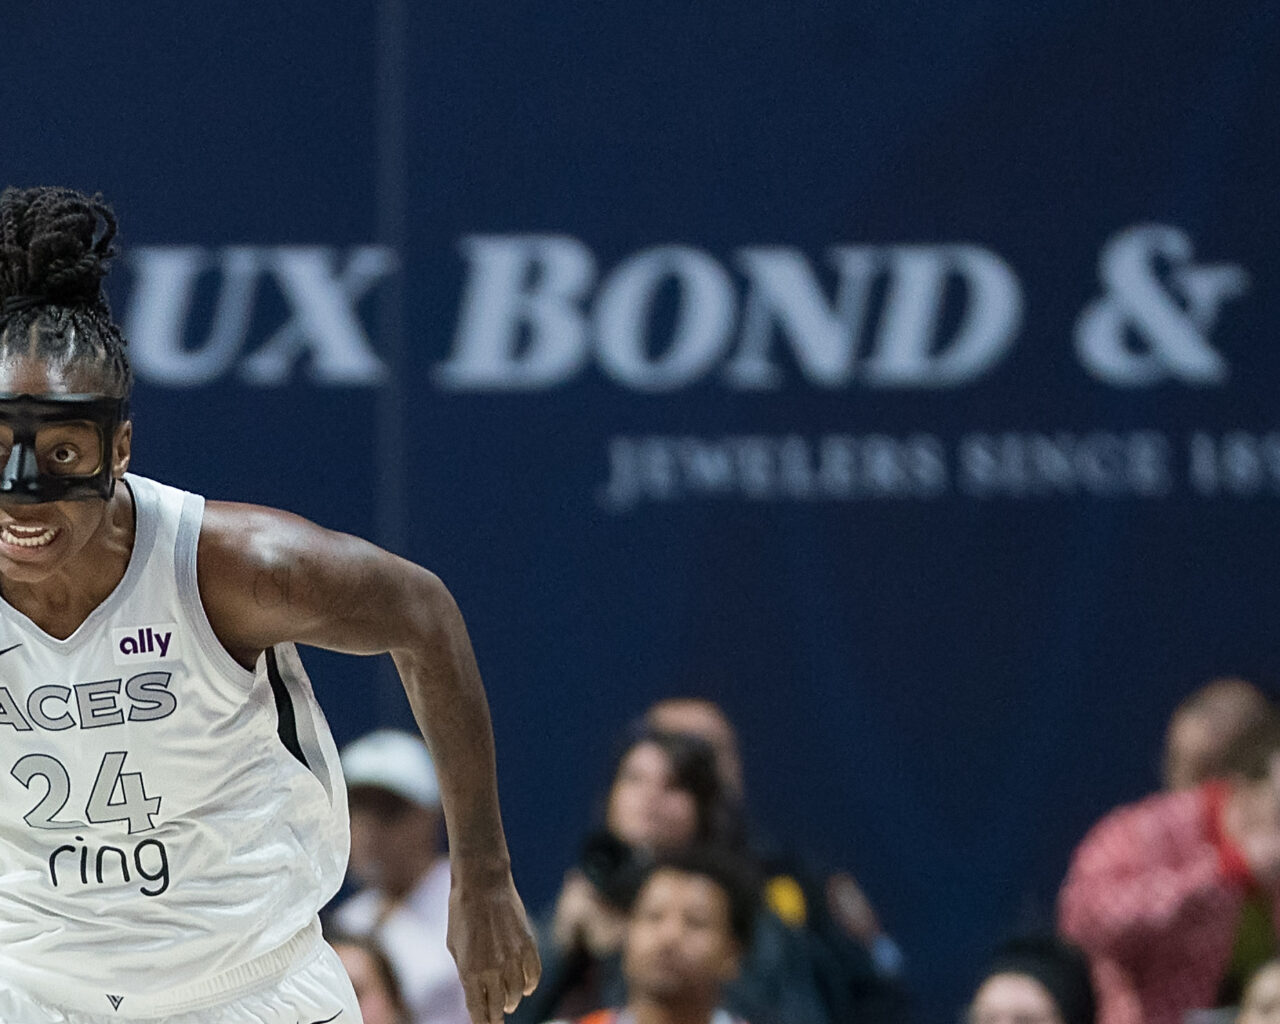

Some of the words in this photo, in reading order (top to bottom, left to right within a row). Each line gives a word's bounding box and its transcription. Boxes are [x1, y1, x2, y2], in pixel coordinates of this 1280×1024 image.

[123, 244, 394, 387] UX
[436, 234, 1024, 391] BOND
[1074, 224, 1246, 388] &
[600, 432, 948, 510] JEWELERS
[958, 432, 1166, 496] SINCE
[119, 627, 172, 657] ally
[10, 751, 162, 835] 24
[49, 835, 170, 896] ring
